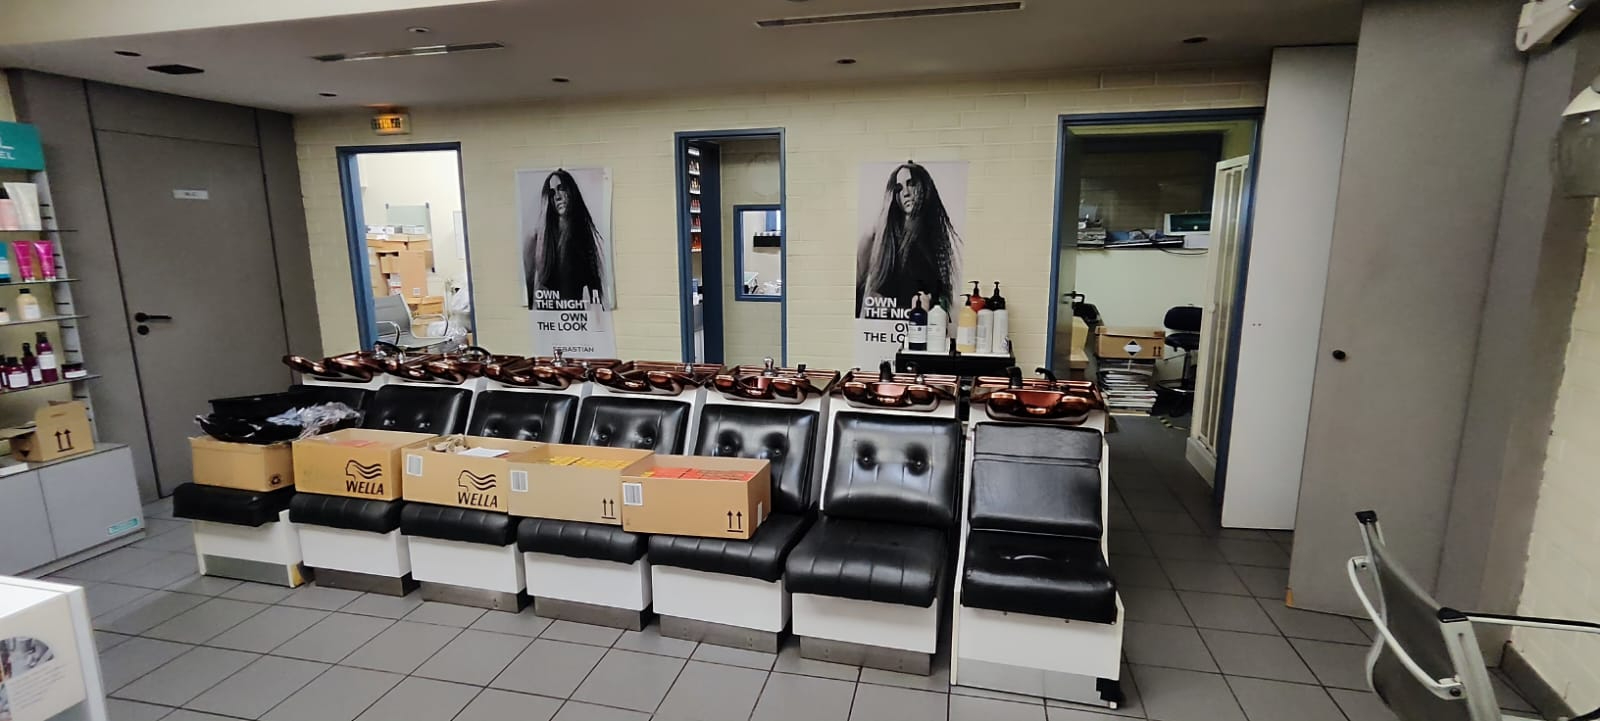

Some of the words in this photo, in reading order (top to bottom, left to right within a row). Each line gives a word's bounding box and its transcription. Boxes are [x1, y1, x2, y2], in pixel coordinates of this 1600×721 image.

[535, 289, 560, 299] OWN
[536, 299, 554, 309] THE
[864, 296, 897, 307] OWN
[560, 312, 588, 321] OWN
[864, 308, 888, 318] THE
[890, 308, 911, 319] NIG
[537, 321, 556, 331] THE
[558, 321, 588, 332] LOOK
[863, 332, 887, 342] THE
[346, 480, 384, 495] WELLA
[458, 491, 498, 508] WELLA
